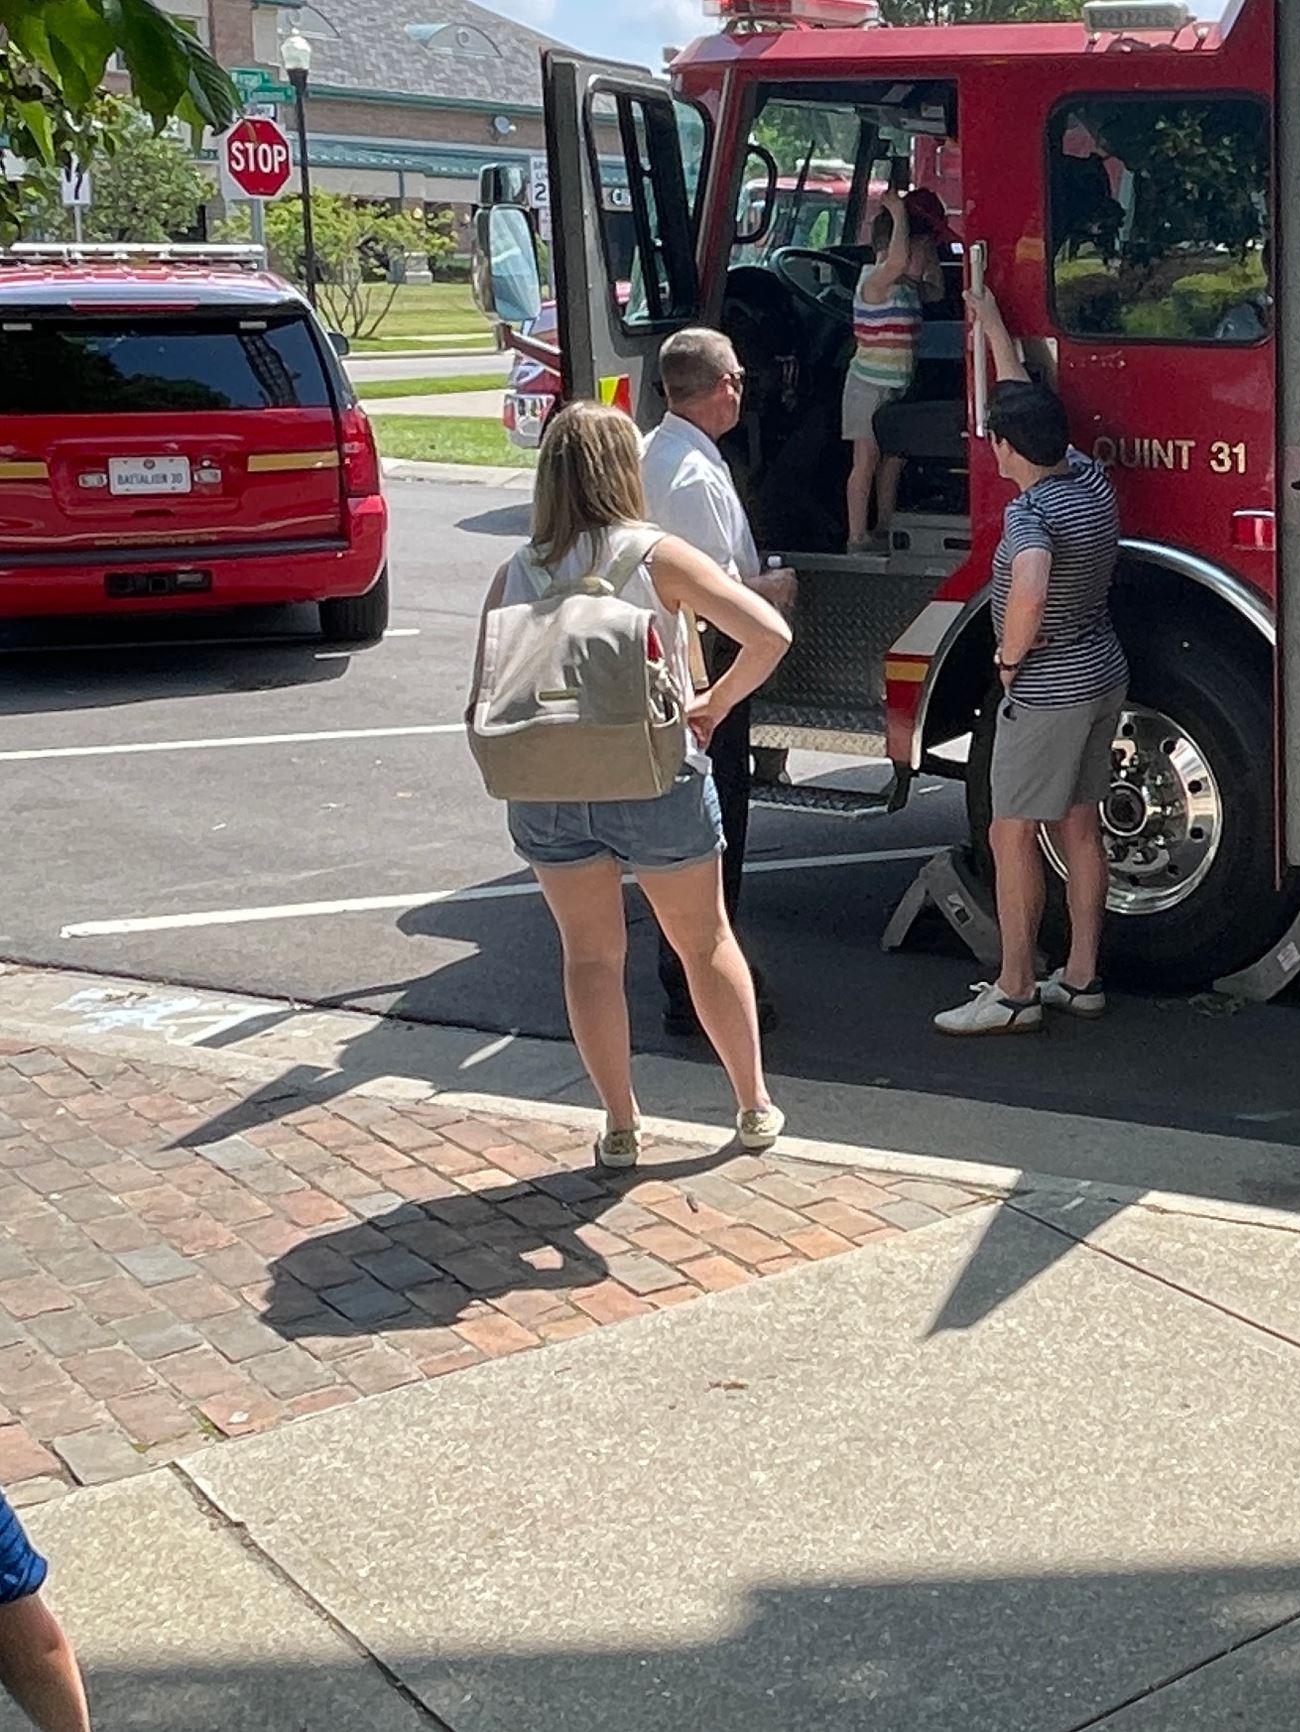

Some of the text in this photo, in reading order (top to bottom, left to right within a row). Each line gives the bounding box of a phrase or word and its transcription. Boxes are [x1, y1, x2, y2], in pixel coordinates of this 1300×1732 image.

[230, 141, 287, 173] STOP
[1092, 436, 1246, 474] QUINT 31
